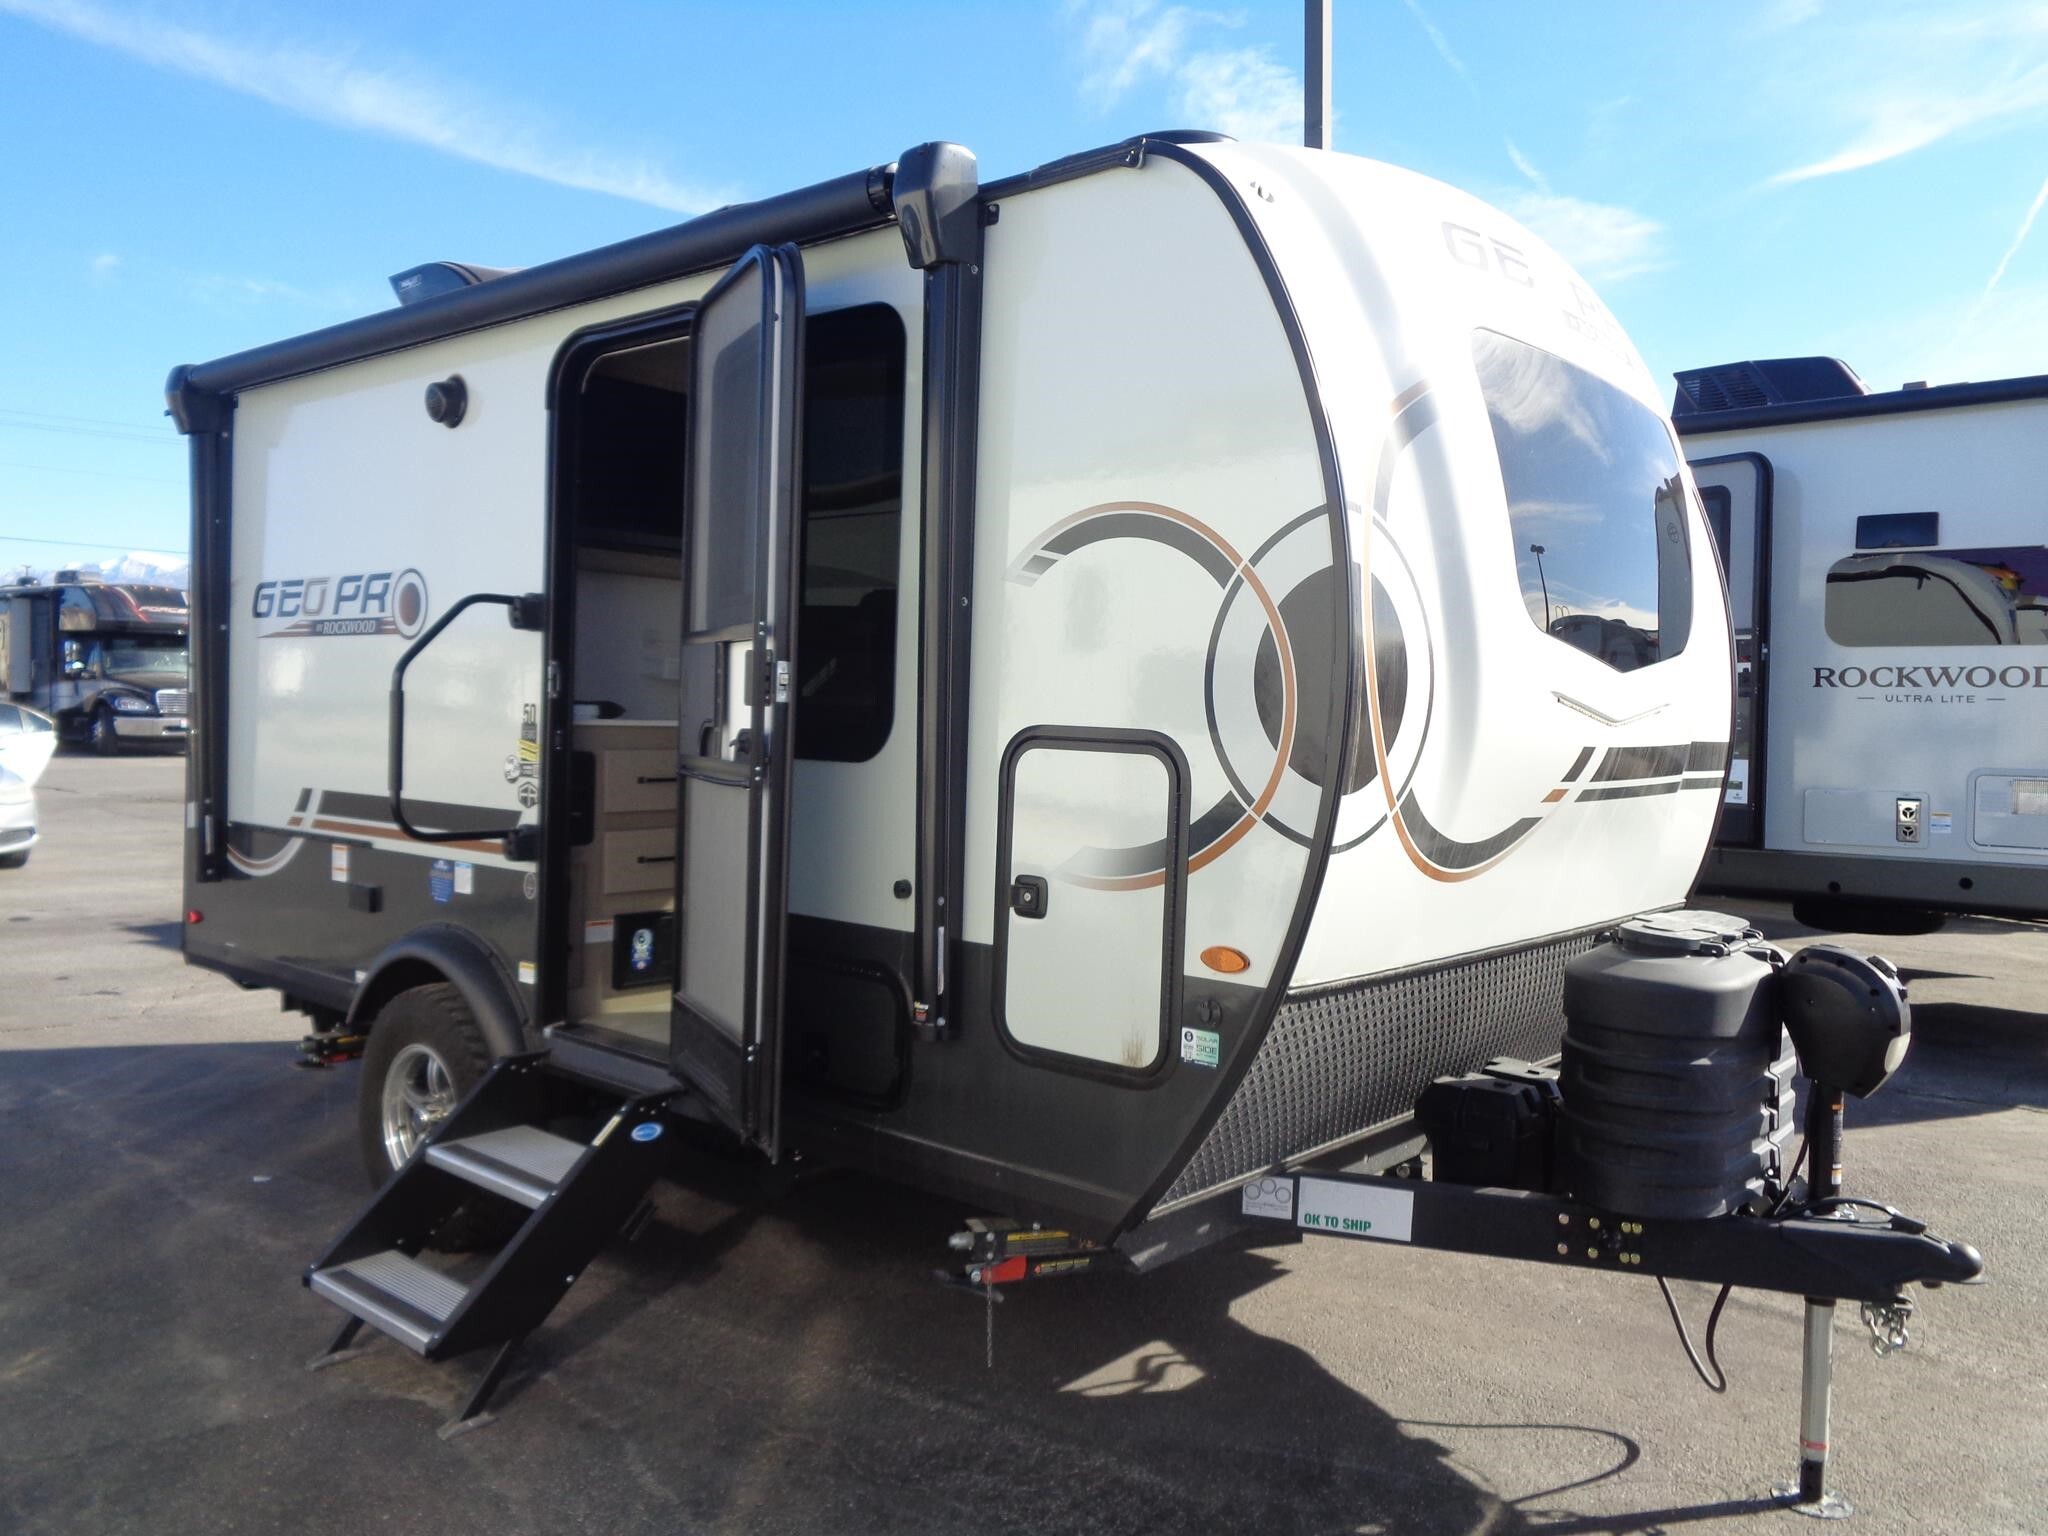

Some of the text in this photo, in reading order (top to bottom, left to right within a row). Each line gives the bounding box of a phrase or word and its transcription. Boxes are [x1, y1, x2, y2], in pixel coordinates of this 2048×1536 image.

[252, 577, 330, 618] GEO
[323, 620, 376, 634] ROCKWOOD
[1885, 694, 1976, 704] ULTRA LITE
[1304, 1213, 1372, 1232] OK TO SHIP
